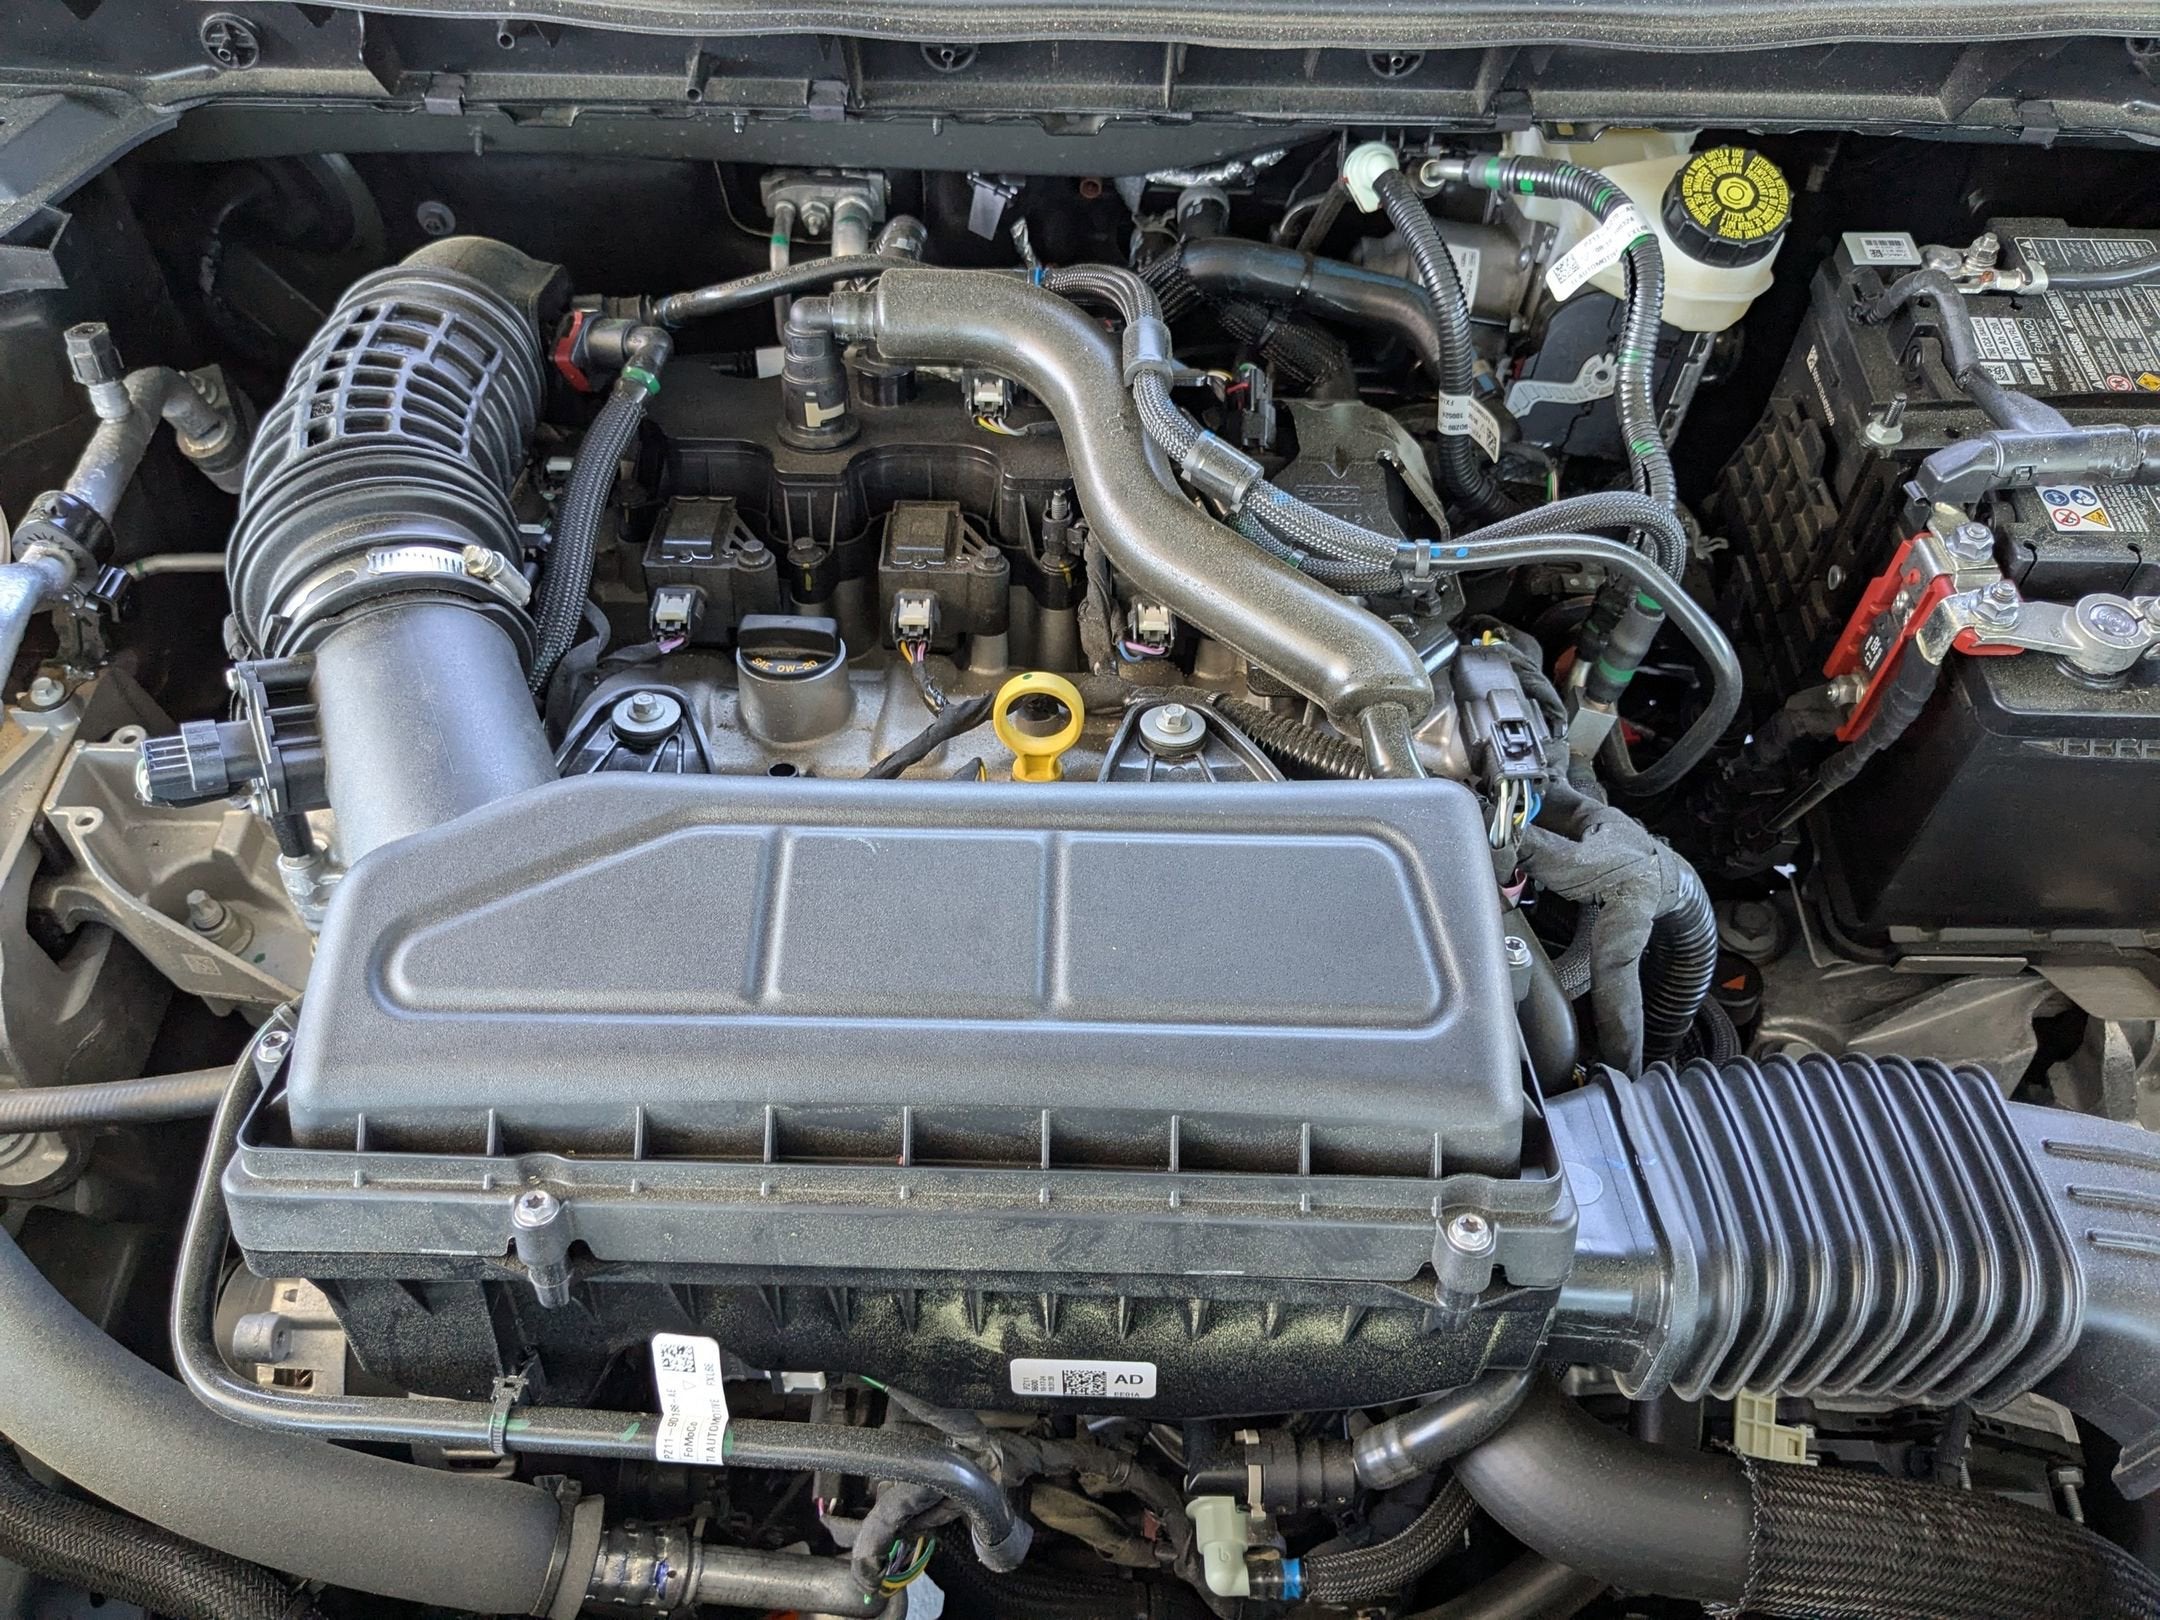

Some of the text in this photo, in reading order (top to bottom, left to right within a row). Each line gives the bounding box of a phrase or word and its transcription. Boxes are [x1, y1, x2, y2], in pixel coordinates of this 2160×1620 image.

[1704, 148, 1724, 162] FLUID
[1693, 193, 1705, 205] USE
[1685, 197, 1711, 227] CONTAINER
[1776, 204, 1788, 213] LE
[1744, 226, 1765, 239] AVANT
[1998, 336, 2008, 346] Ah
[2005, 321, 2028, 358] AGM/VRLA
[2024, 319, 2043, 353] FoMoCo
[2002, 347, 2012, 356] 70
[2067, 333, 2087, 356] POISON
[2036, 357, 2054, 372] MF
[2026, 367, 2039, 379] 12V
[752, 658, 818, 672] SAE 0W-20
[1114, 1374, 1144, 1385] AD
[706, 1399, 722, 1454] AUTOMOTIVE
[684, 1421, 698, 1458] FoMoCo
